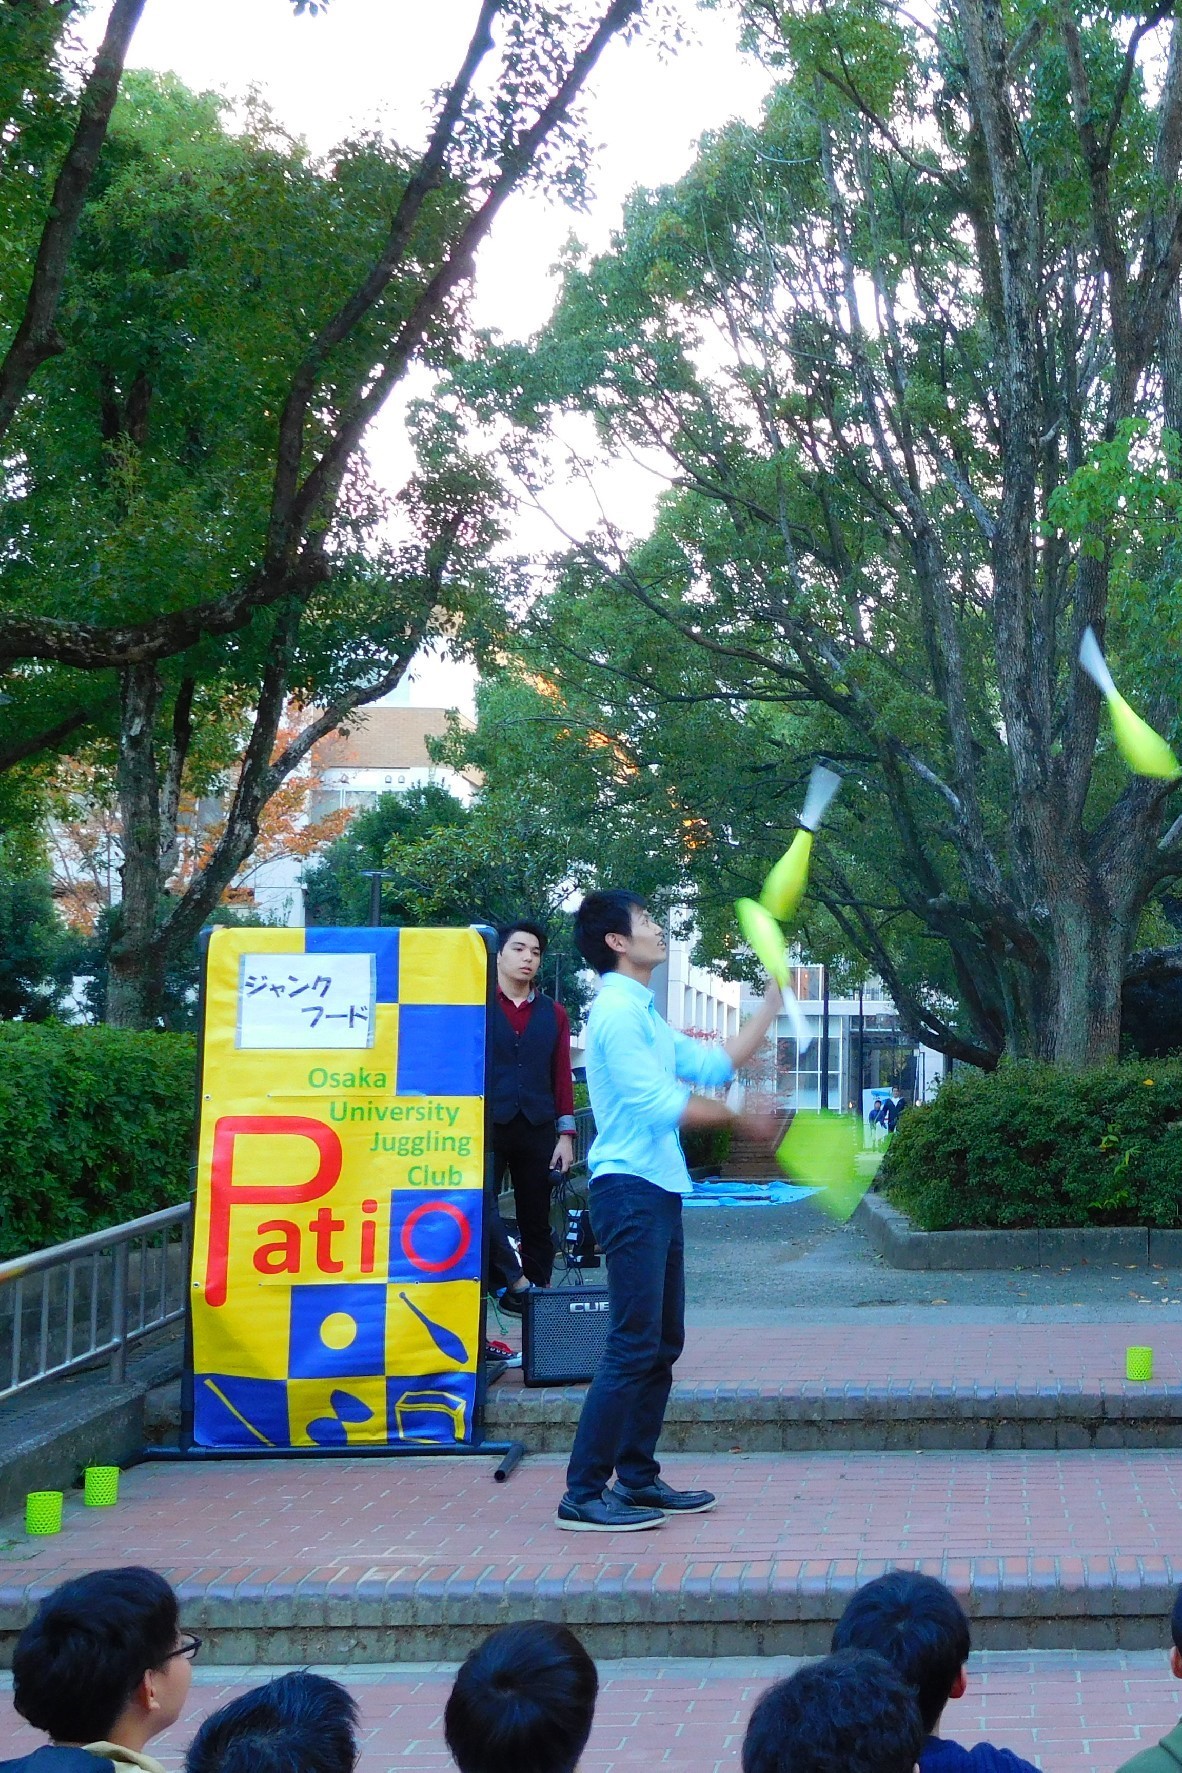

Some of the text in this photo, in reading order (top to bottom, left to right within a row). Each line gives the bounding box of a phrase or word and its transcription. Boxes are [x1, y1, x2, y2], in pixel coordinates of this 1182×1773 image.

[245, 975, 332, 998] ジャンク
[301, 1005, 368, 1028] フード
[307, 1066, 387, 1089] Osaka
[329, 1100, 460, 1126] University
[369, 1130, 472, 1157] Juggling
[407, 1164, 463, 1187] Club
